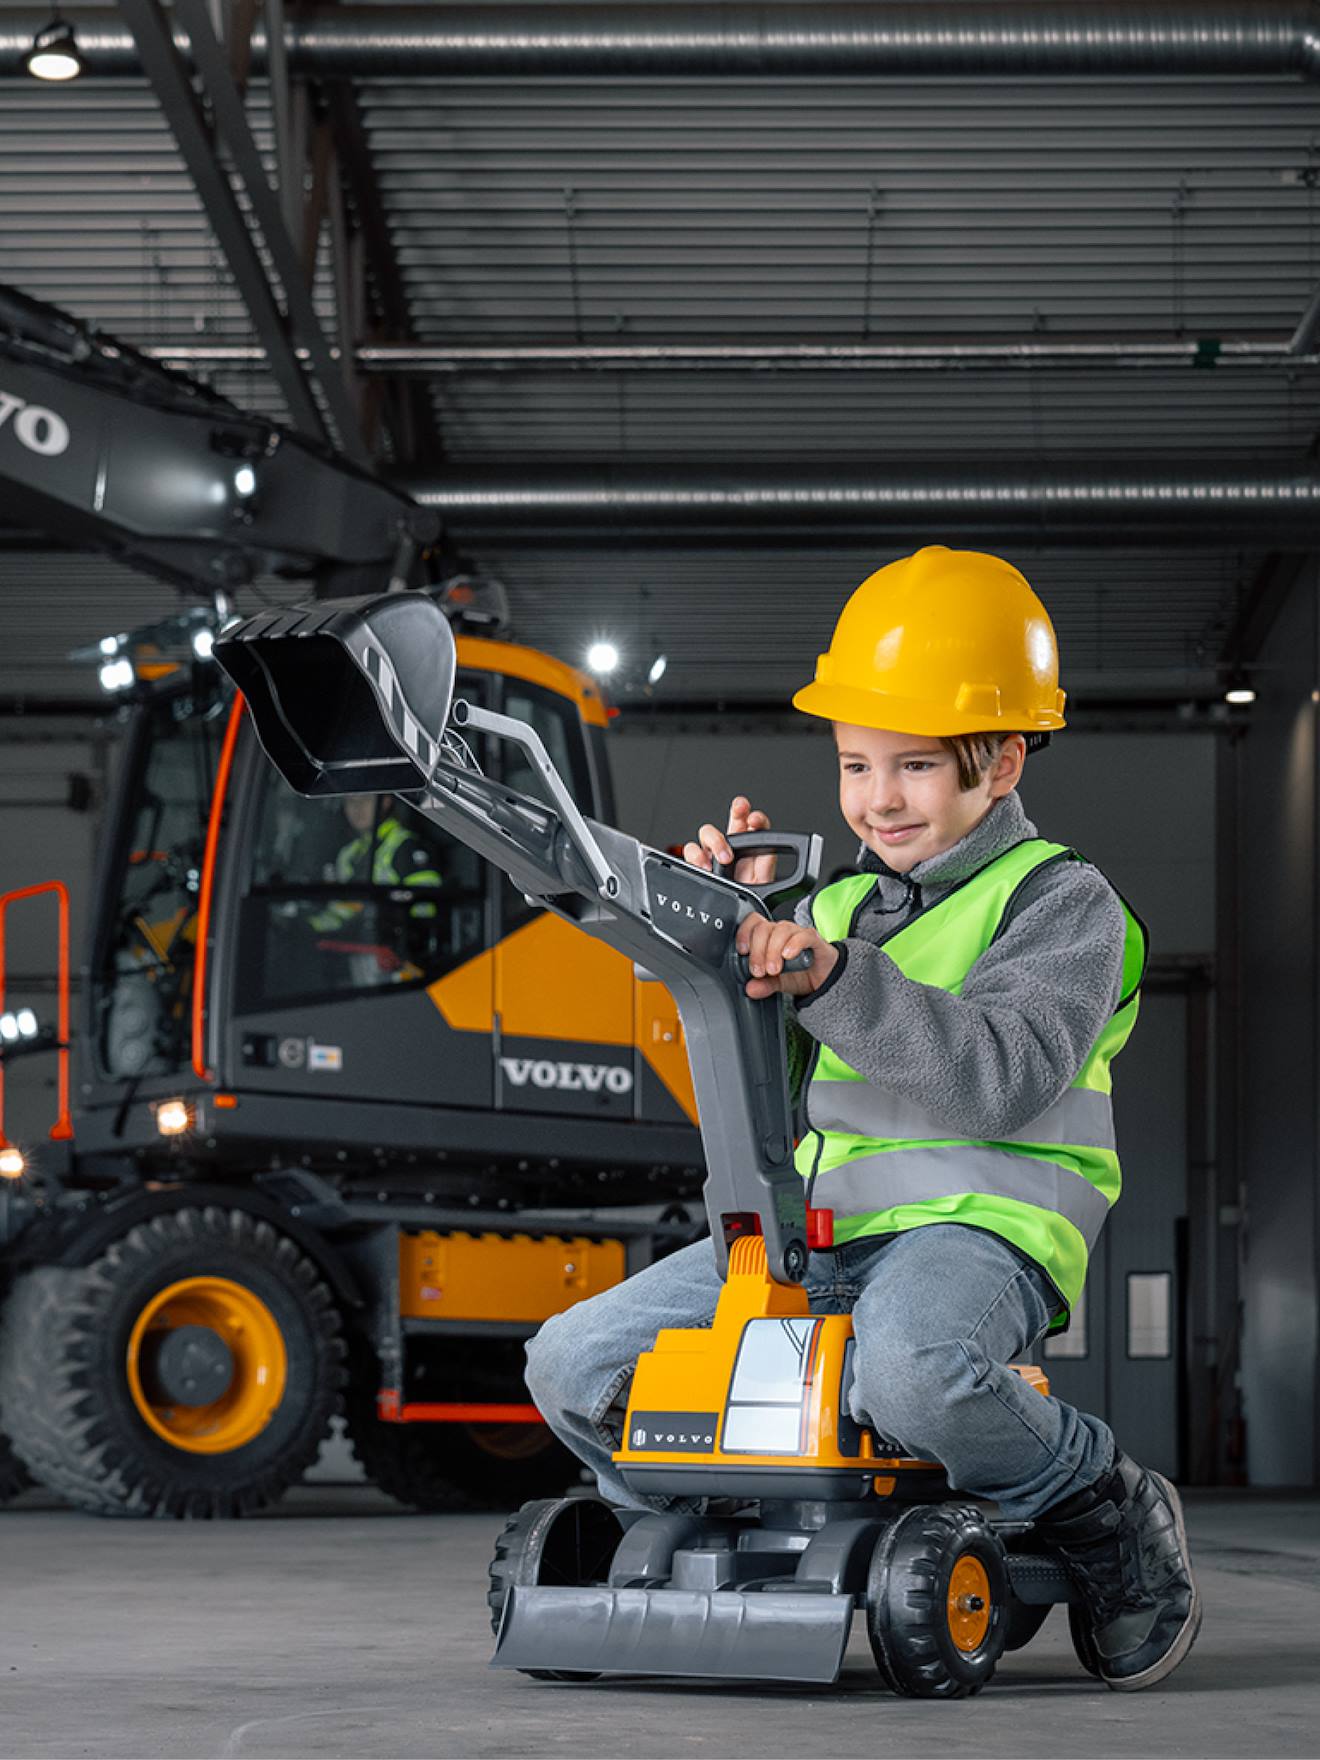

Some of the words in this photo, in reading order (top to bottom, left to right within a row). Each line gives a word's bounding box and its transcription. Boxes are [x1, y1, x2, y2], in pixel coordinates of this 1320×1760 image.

[656, 893, 723, 930] VOLVO
[499, 1057, 633, 1094] VOLVO
[655, 1434, 713, 1444] VOLVO
